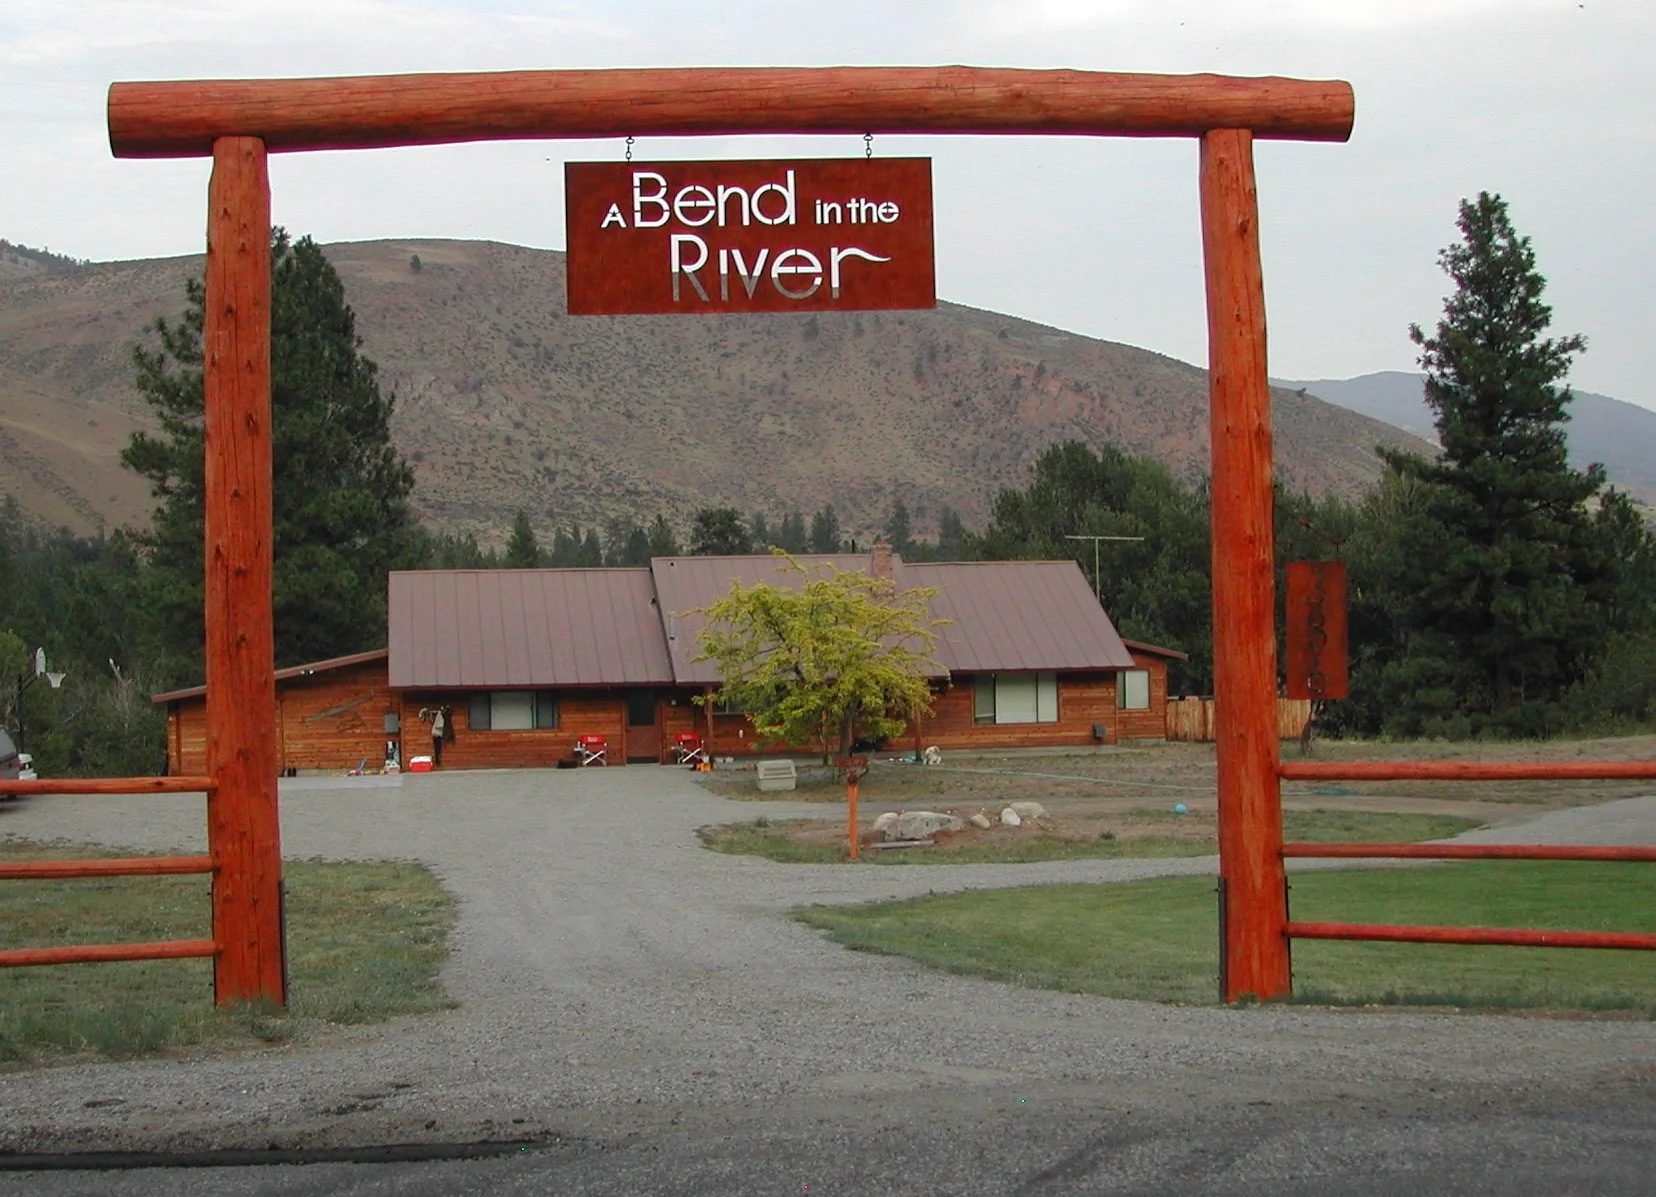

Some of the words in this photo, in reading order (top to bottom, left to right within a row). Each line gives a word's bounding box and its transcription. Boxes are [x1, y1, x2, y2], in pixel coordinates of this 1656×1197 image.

[601, 203, 627, 228] A
[632, 170, 797, 228] Bend
[815, 199, 841, 224] in
[847, 197, 899, 223] the
[670, 233, 891, 302] River
